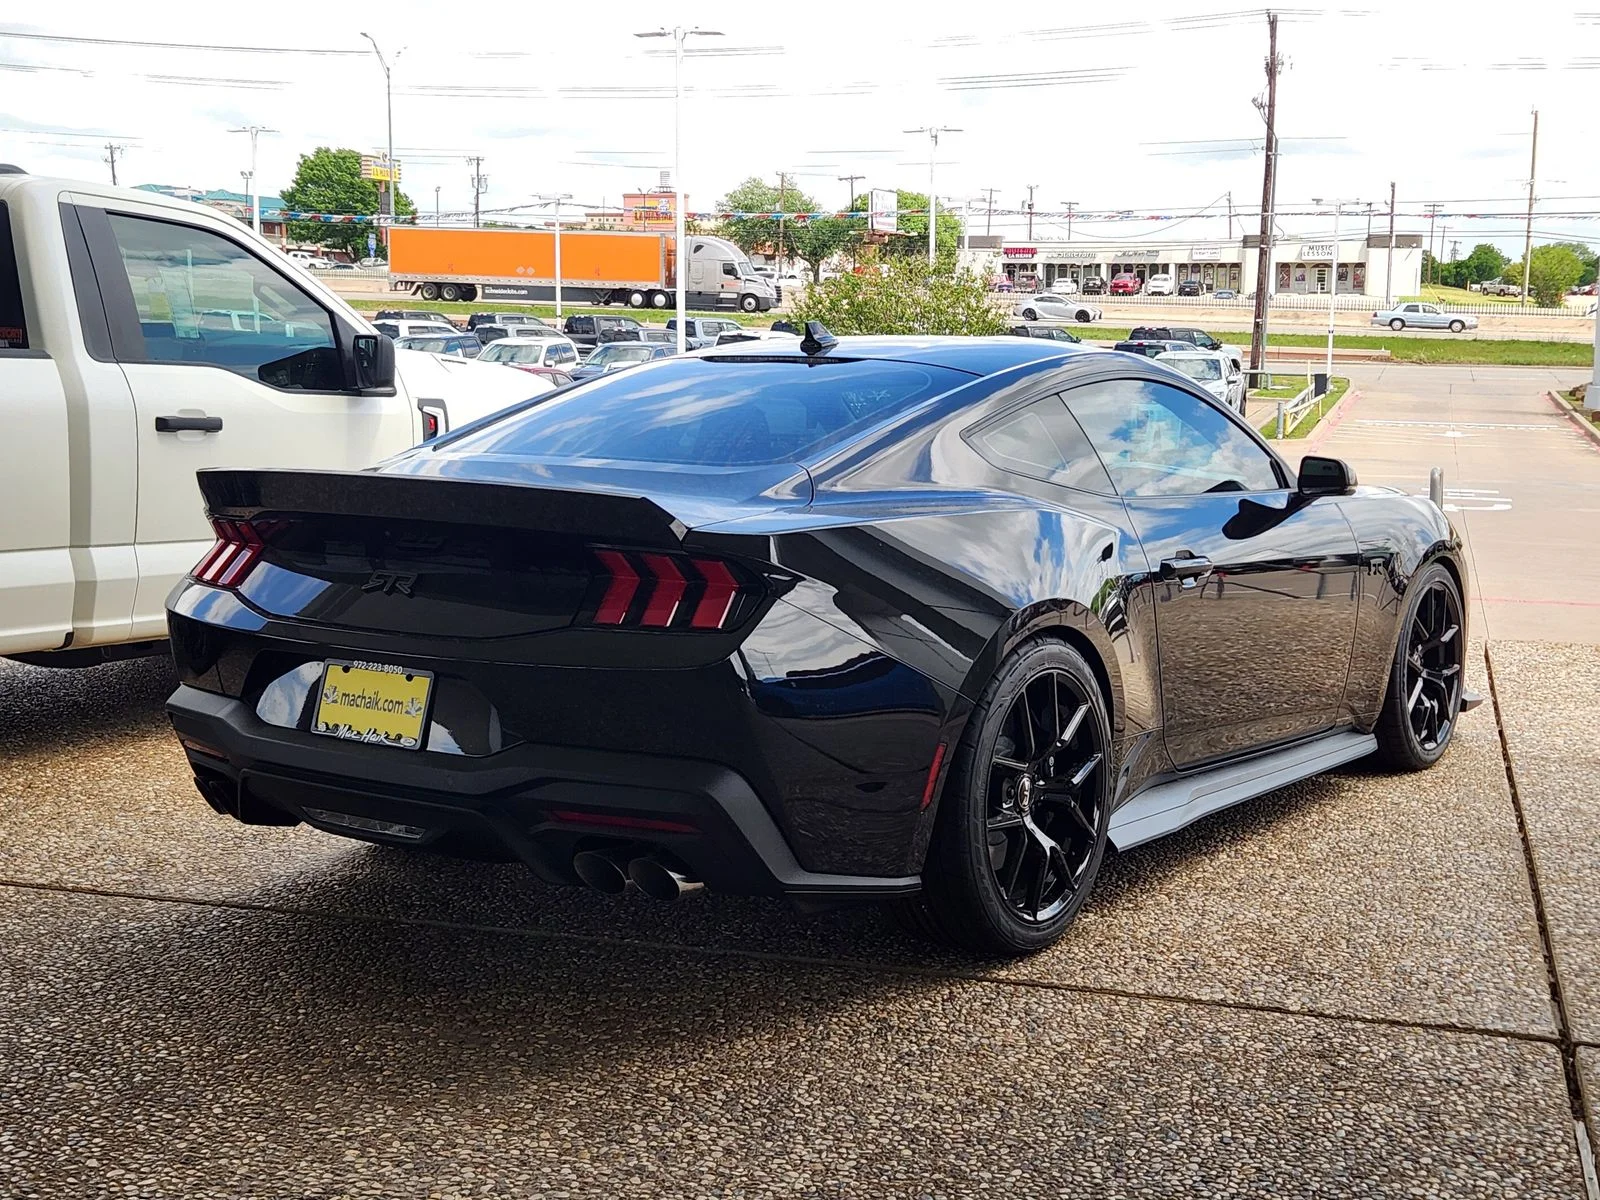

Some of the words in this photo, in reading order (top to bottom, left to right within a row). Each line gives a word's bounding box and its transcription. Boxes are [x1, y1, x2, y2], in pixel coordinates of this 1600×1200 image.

[1308, 244, 1333, 252] MUSIC
[353, 660, 403, 674] 972-223-8050
[340, 688, 404, 715] machaik.com
[336, 723, 360, 740] Mac
[360, 727, 394, 745] Haik
